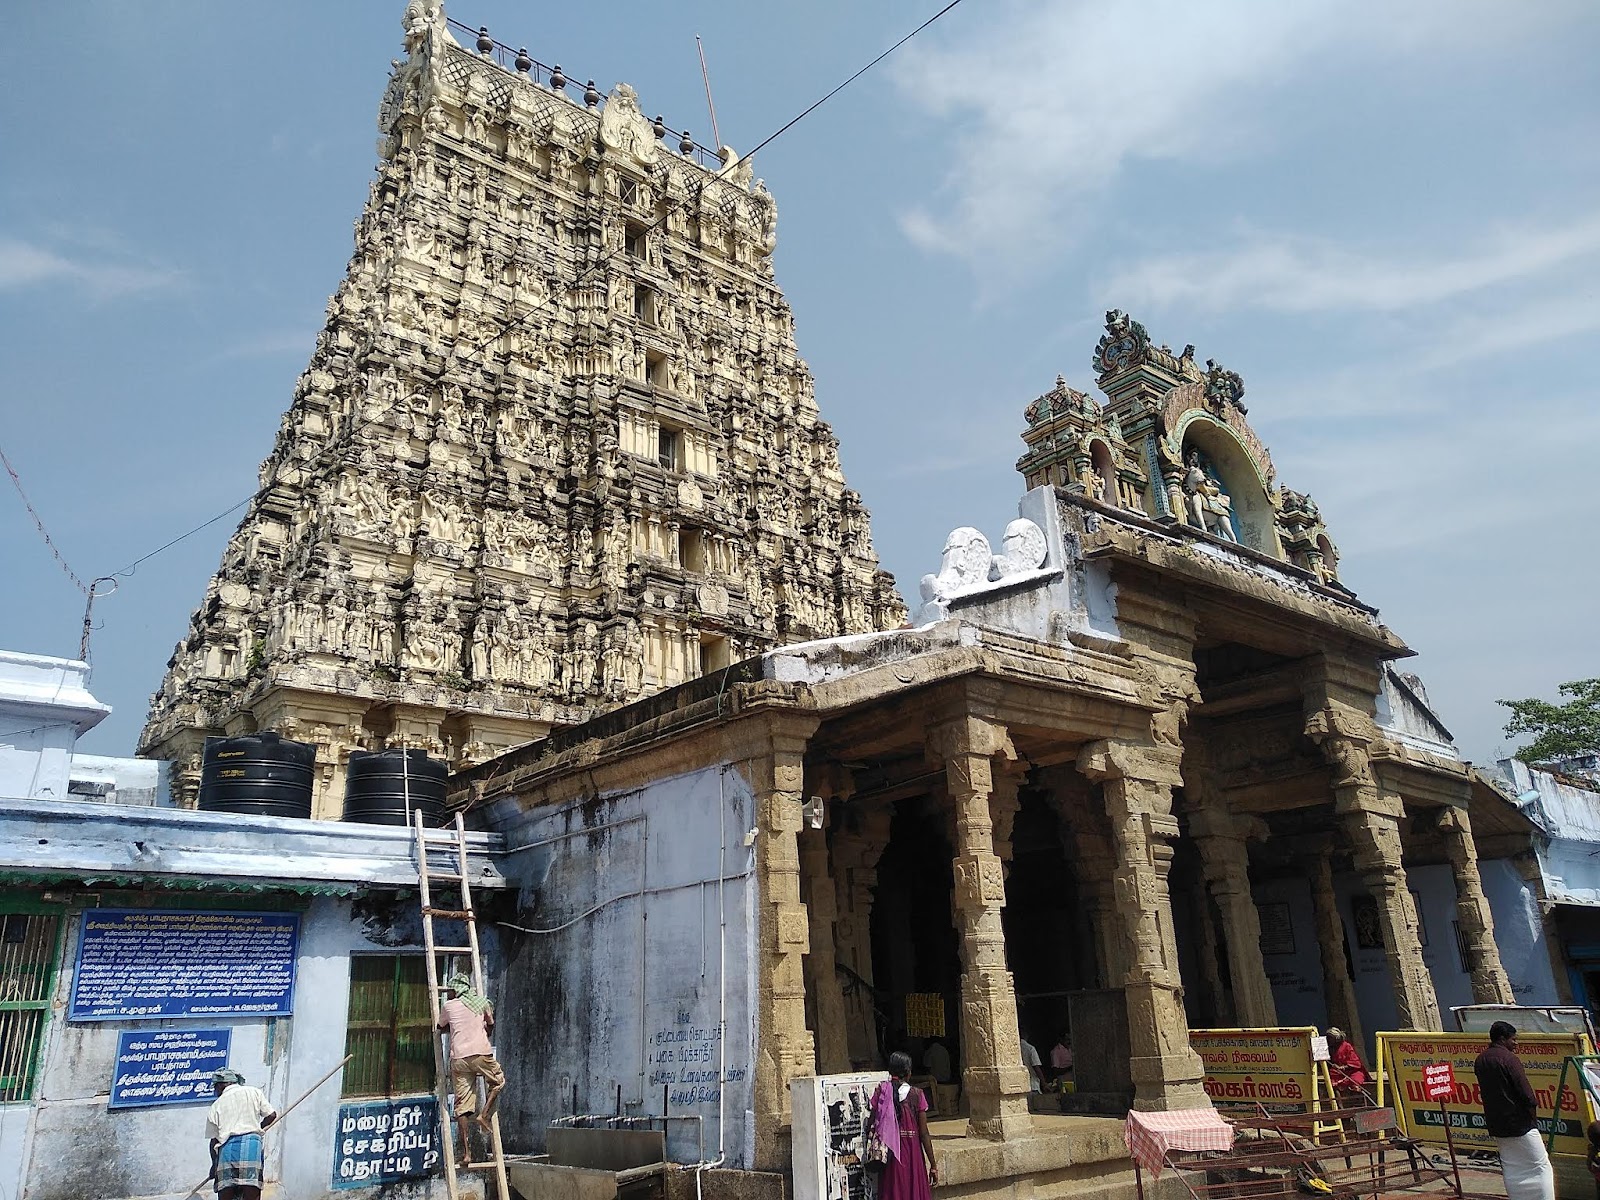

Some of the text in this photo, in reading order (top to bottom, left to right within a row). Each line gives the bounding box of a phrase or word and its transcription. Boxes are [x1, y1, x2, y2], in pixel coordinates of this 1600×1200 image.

[151, 1060, 191, 1070] பாபநாசம்
[1200, 1050, 1278, 1064] ாவல் நிலையம்
[116, 1070, 176, 1086] திருக்கோயில்
[1204, 1075, 1302, 1099] ஸ்கர் லாட்ஜ்
[119, 1084, 157, 1098] வாகனம்
[342, 1105, 422, 1133] மழைநீர்
[342, 1130, 431, 1156] சேகரிப்பு
[340, 1150, 439, 1181] தொட்டி 2
